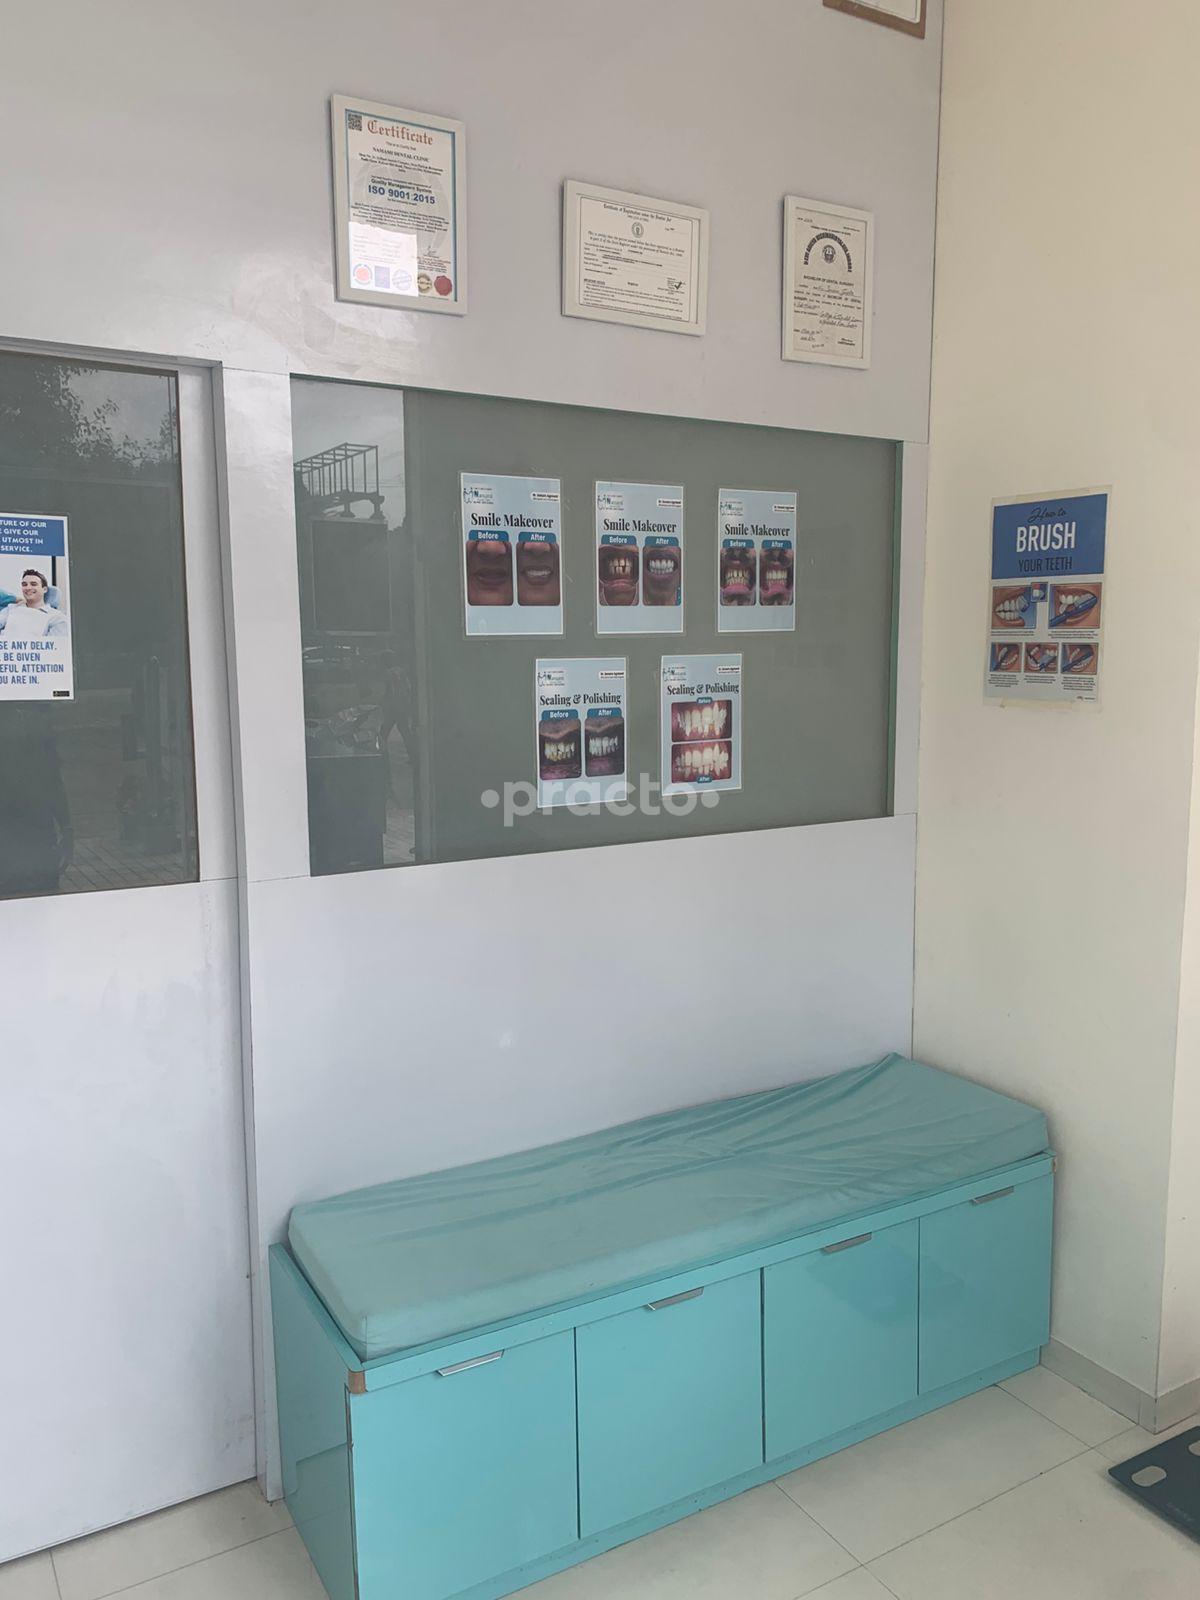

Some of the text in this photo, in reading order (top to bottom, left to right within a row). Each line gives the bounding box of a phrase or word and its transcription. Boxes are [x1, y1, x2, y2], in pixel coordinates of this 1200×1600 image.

[367, 120, 433, 145] Certificate
[368, 185, 386, 196] ISO
[371, 178, 387, 186] Quality
[387, 181, 416, 190] Management
[416, 186, 433, 194] System
[1057, 507, 1067, 517] to
[471, 512, 554, 529] Smile Makeover
[603, 518, 677, 533] Smile Makeover
[724, 523, 790, 537] Smile Makeover
[477, 531, 545, 542] Before After
[609, 536, 669, 545] Before After
[1016, 521, 1076, 553] BRUSH
[1018, 556, 1073, 573] YOUR TEETH
[11, 641, 28, 650] ANY
[30, 641, 57, 651] DELAY.
[3, 652, 14, 661] BE
[16, 652, 41, 661] GIVEN
[22, 664, 64, 673] ATTENTION
[11, 675, 27, 684] ARE
[29, 675, 40, 685] IN.
[667, 682, 739, 697] Scaling & Polishing
[540, 692, 621, 707] Scaling & Polishing
[550, 711, 569, 719] Before
